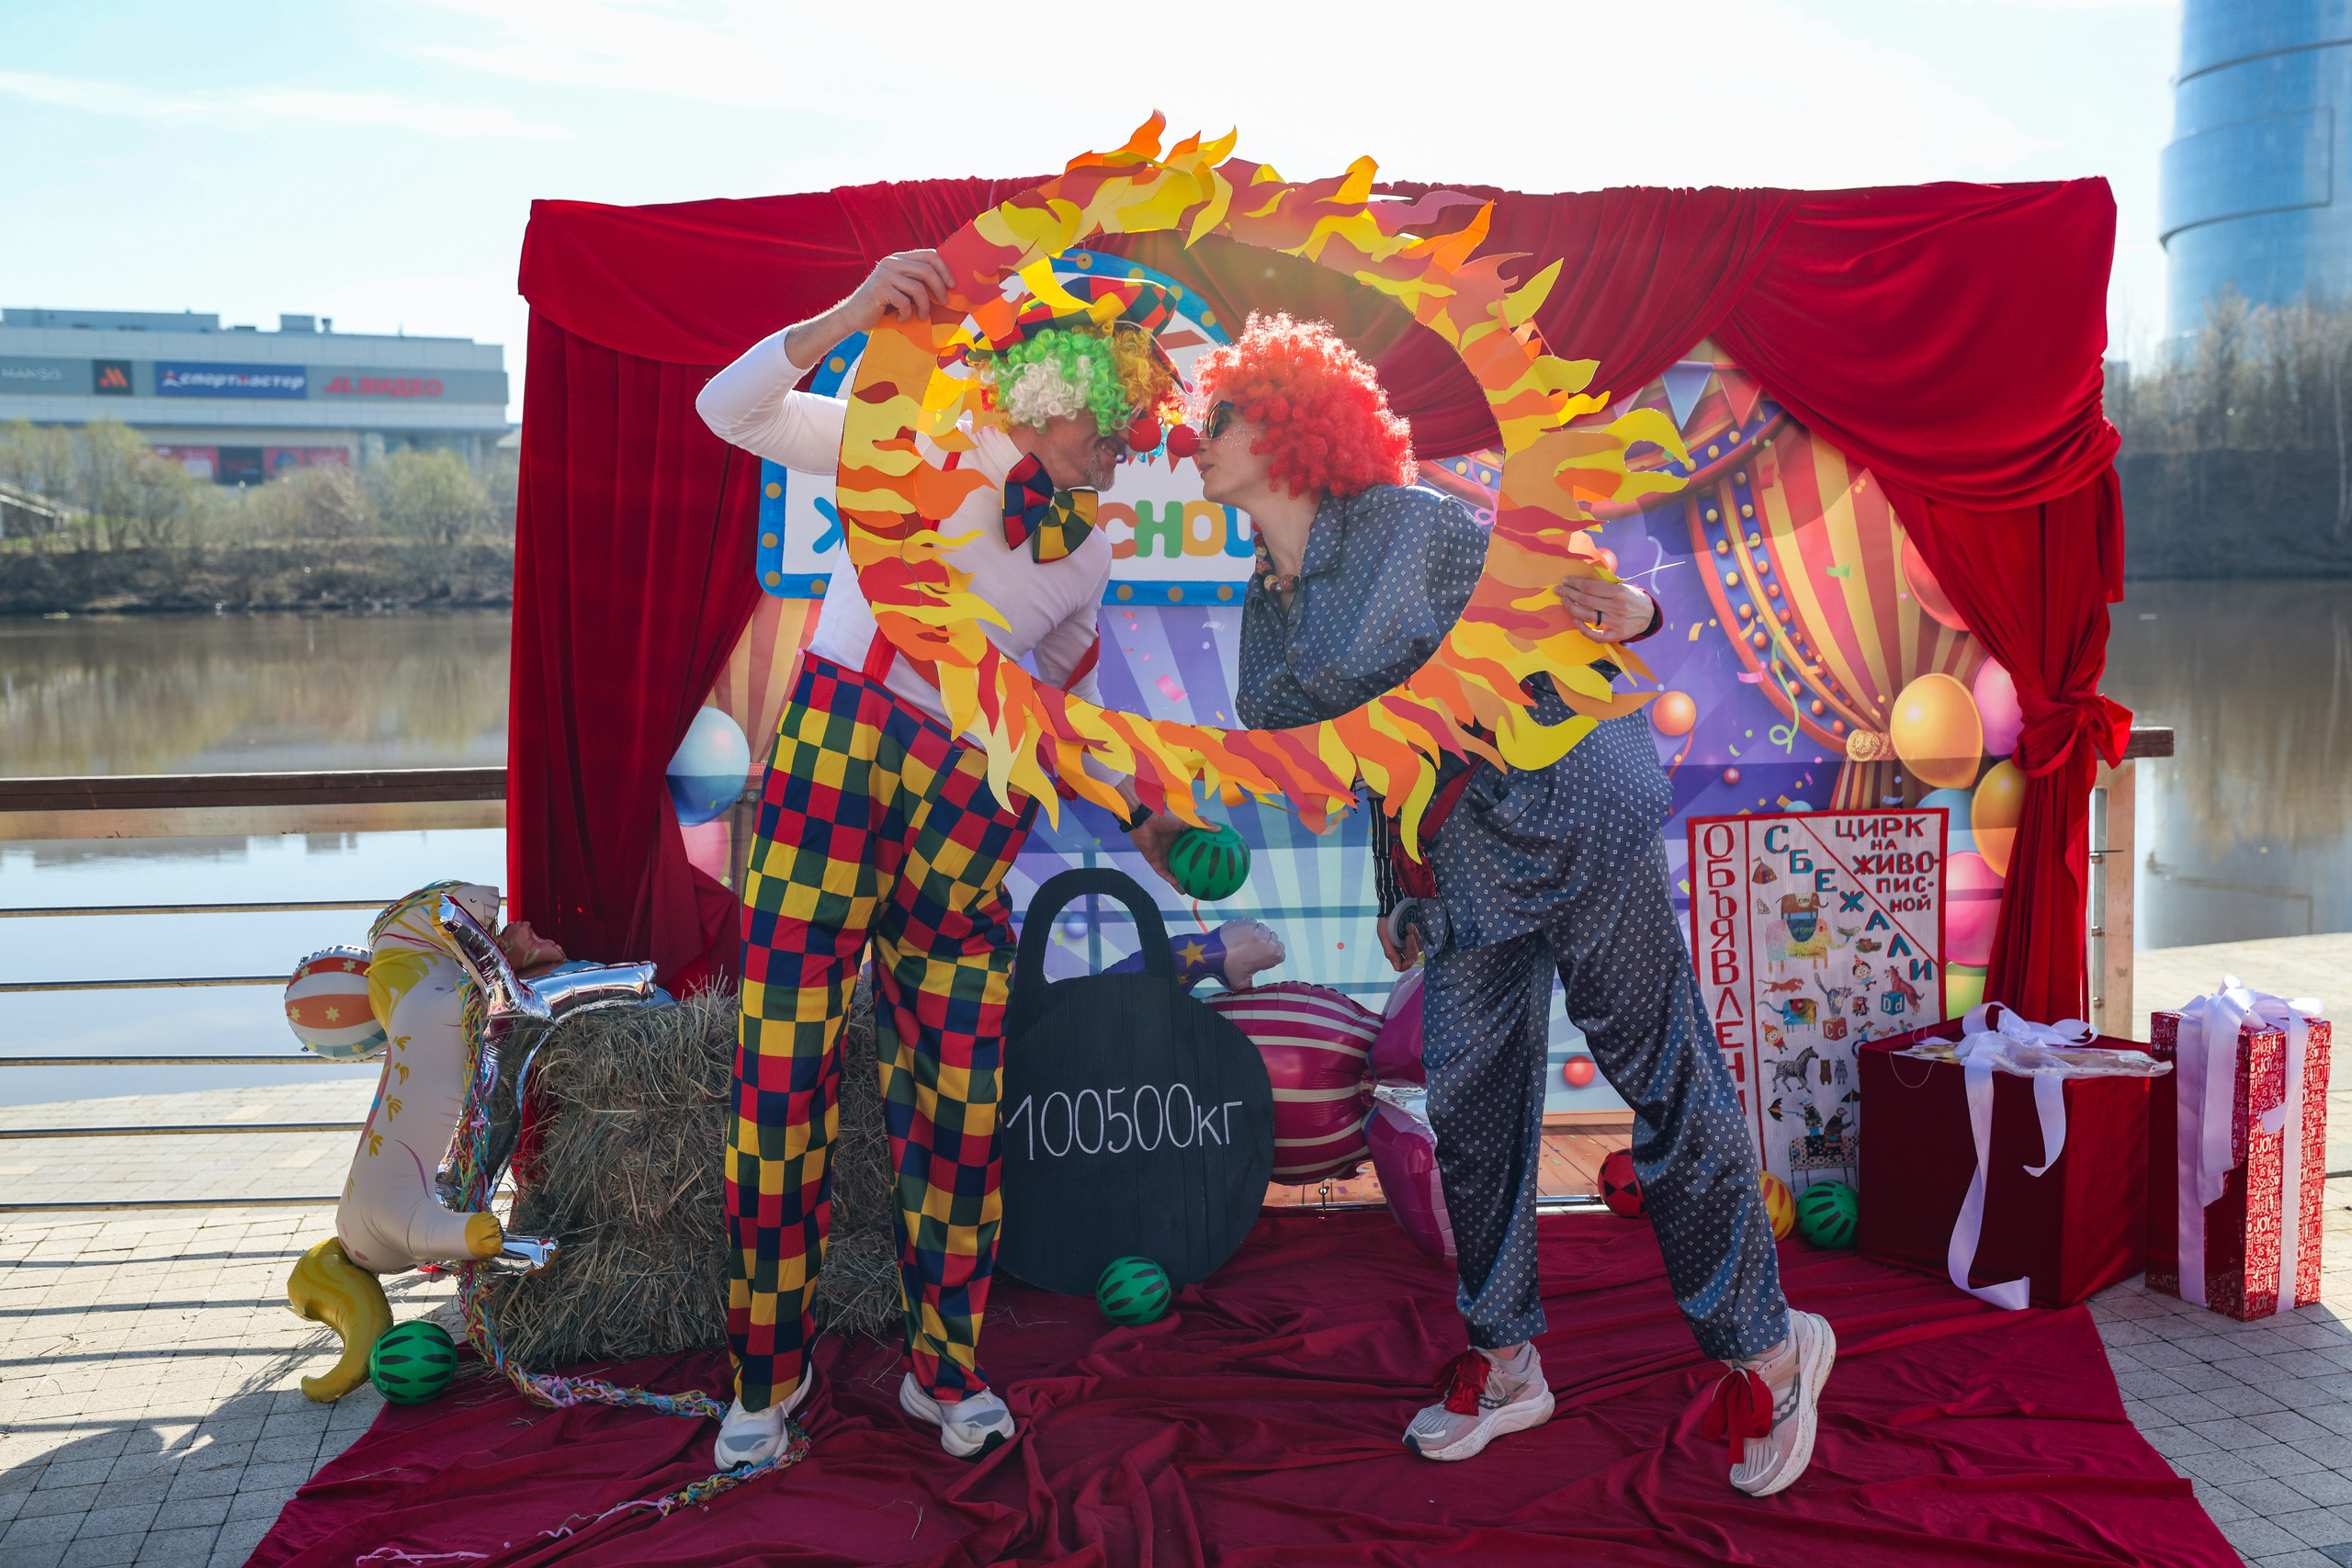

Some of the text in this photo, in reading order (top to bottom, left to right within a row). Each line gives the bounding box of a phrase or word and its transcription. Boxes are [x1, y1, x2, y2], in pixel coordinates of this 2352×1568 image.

[1835, 817, 1928, 842] ЦИРК
[1871, 839, 1898, 852] НА
[1876, 875, 1935, 894] ПИС-
[1890, 894, 1931, 913] НОЙ
[1703, 824, 1747, 1116] ОБЪЯВЛЕН
[1006, 1083, 1243, 1161] 100500кг
[2256, 1134, 2274, 1153] JOY
[2254, 1213, 2272, 1233] JOY
